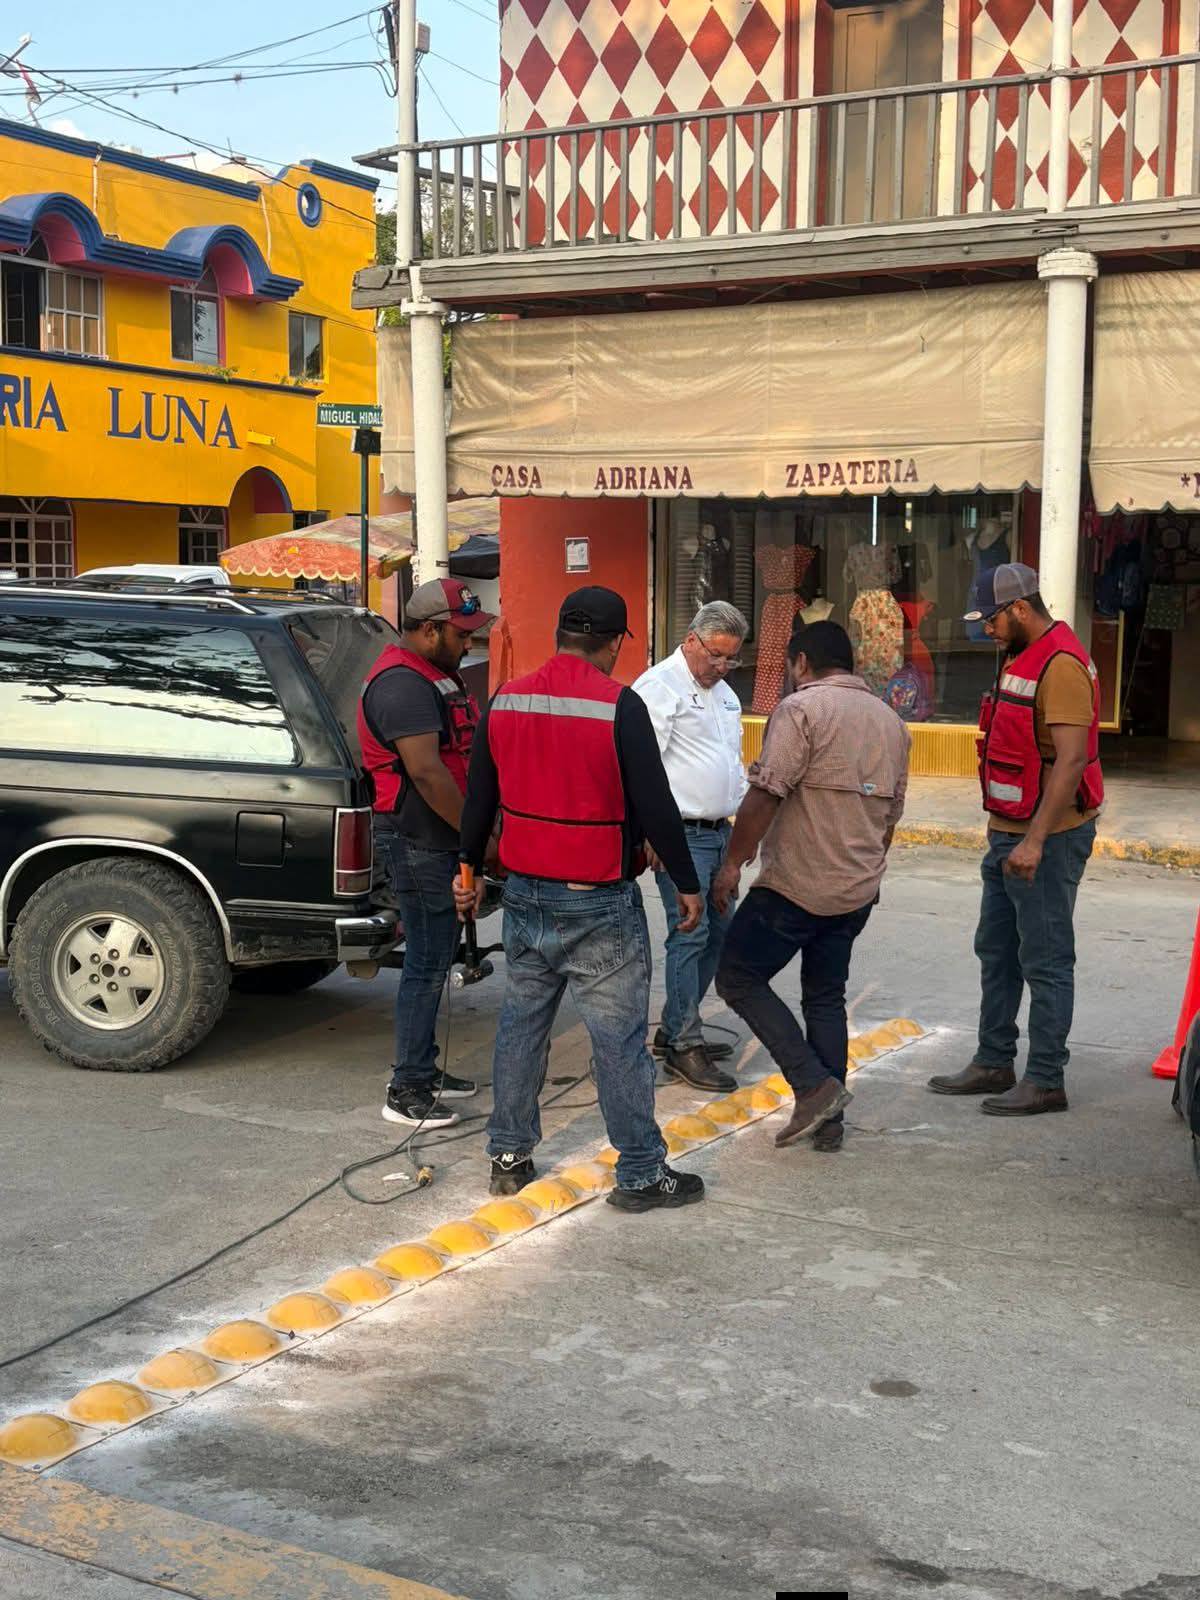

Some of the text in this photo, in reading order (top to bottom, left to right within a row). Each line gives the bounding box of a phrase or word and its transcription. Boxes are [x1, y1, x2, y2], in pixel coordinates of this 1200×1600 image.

[0, 374, 243, 449] RIA LUNA
[320, 409, 357, 424] MIGUEL
[491, 458, 918, 490] CASA ADRIANA ZAPATERIA
[501, 1153, 514, 1162] NB
[660, 1176, 677, 1194] N
